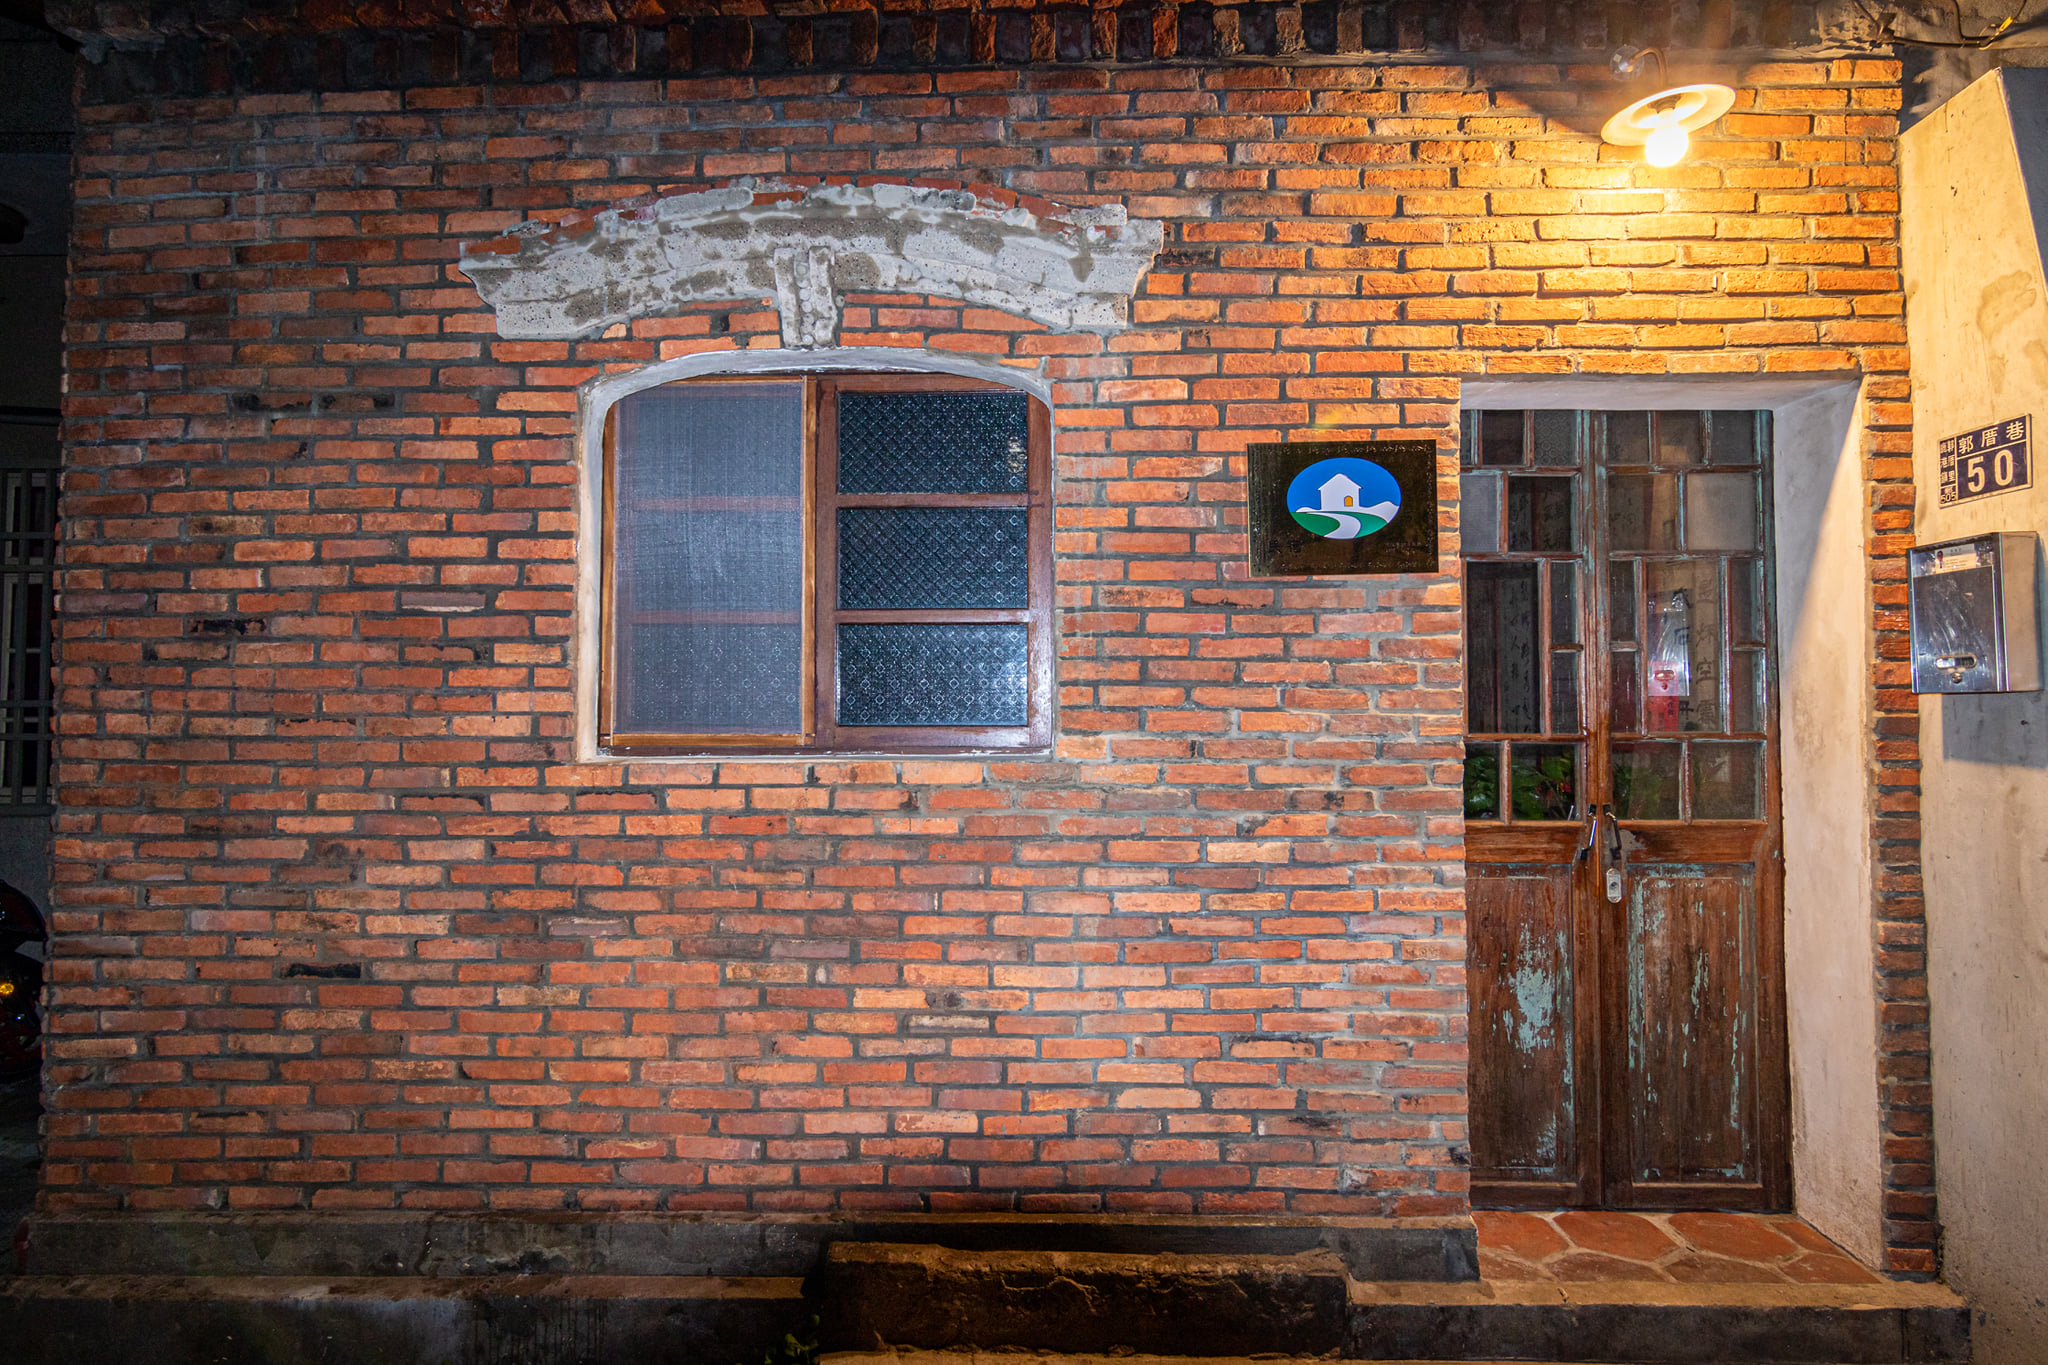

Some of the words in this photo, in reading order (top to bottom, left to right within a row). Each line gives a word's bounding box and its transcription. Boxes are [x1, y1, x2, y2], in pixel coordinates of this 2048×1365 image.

[1958, 421, 2024, 454] 郭厝巷
[1967, 449, 2014, 493] 50
[1941, 491, 1956, 503] 505
